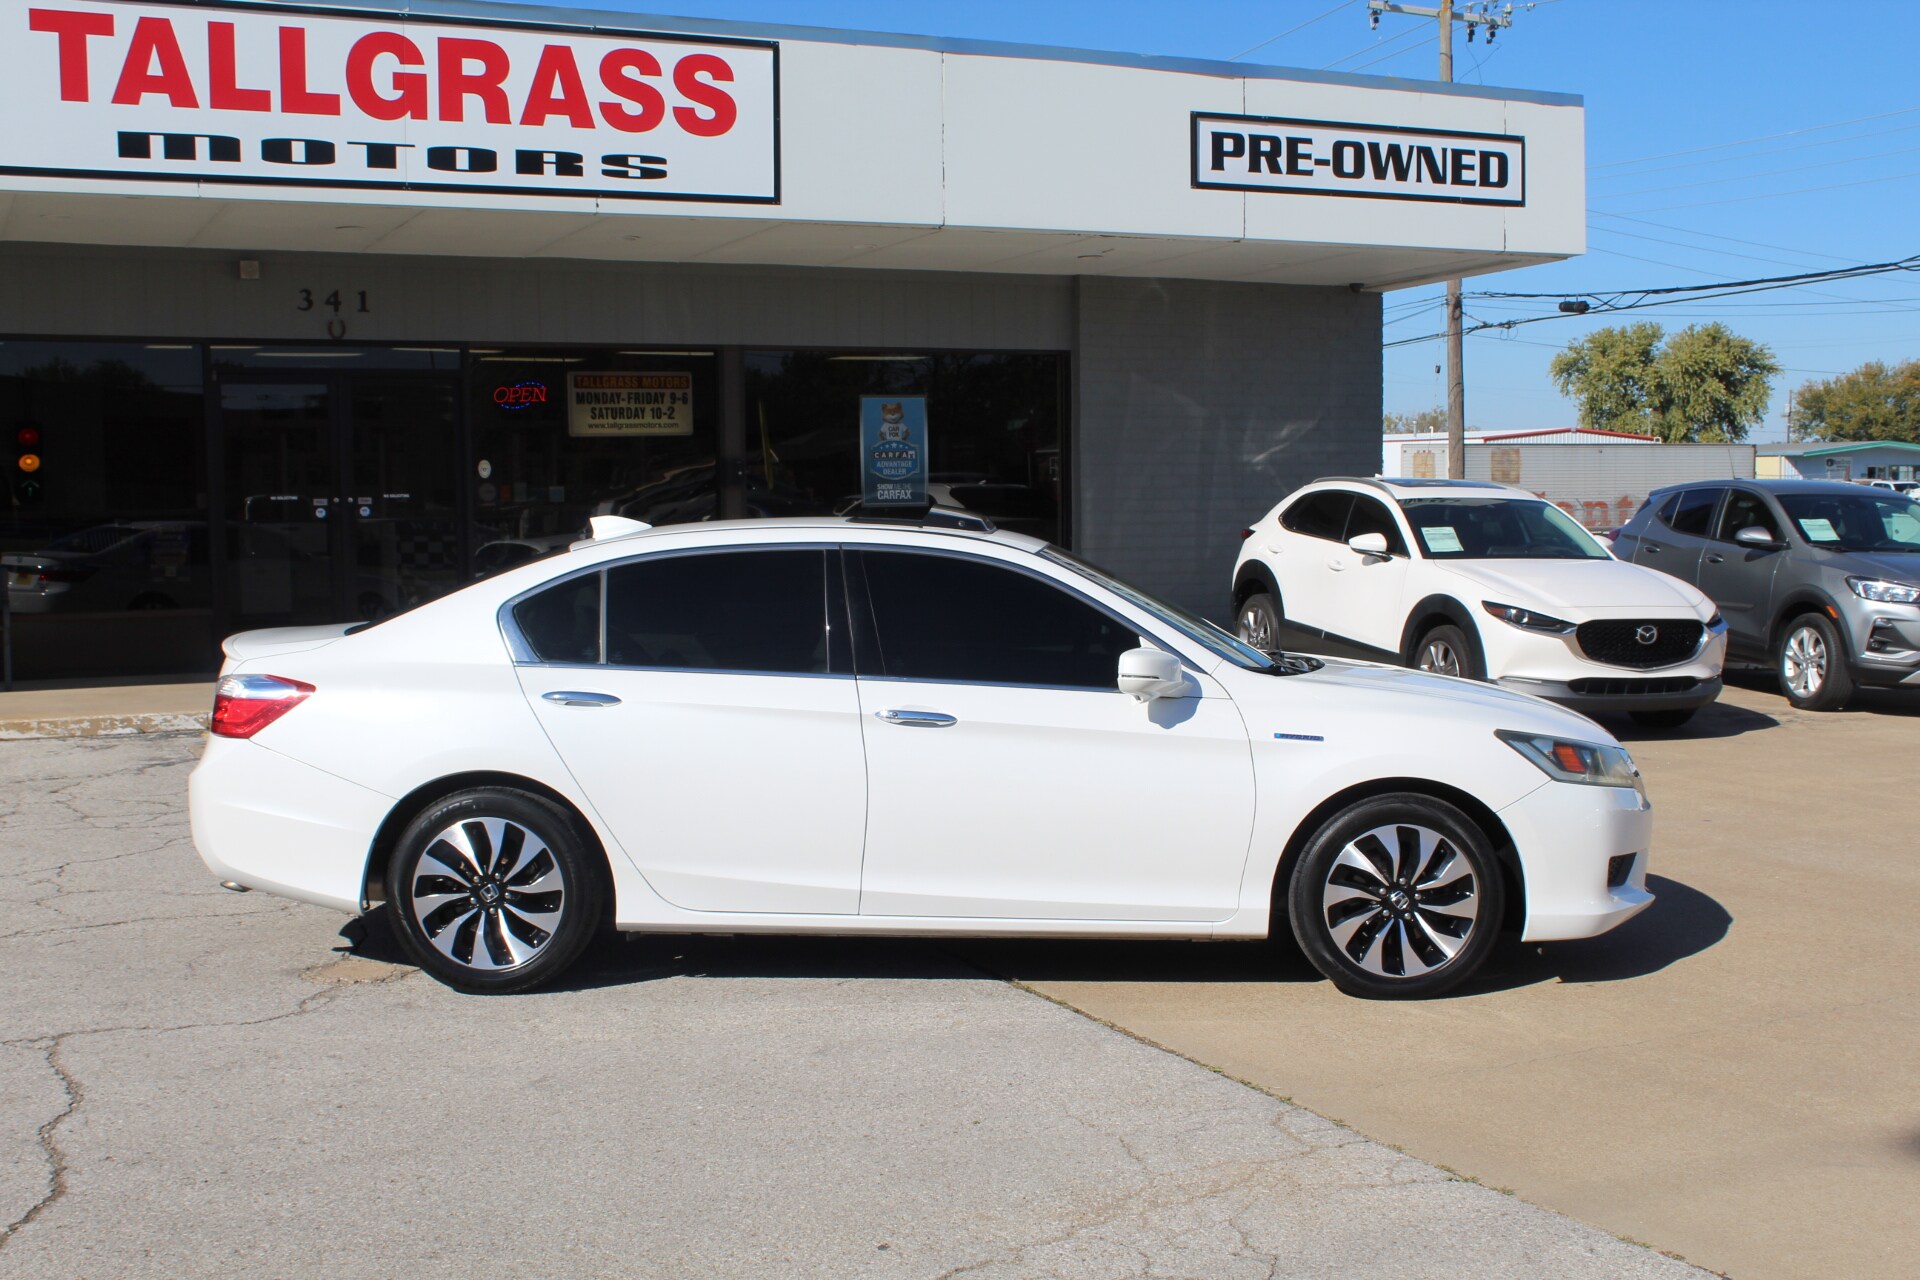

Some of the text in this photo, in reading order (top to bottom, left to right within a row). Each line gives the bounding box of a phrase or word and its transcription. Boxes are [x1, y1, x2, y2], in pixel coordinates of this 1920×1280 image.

[28, 8, 738, 137] TALLGRASS
[117, 130, 668, 180] MOTORS
[1210, 131, 1509, 189] PRE-OWNED
[297, 288, 370, 313] 341
[576, 376, 688, 388] TALLGRASS MOTORS
[493, 385, 548, 404] OPEN
[576, 391, 688, 405] MONDAY-FRIDAY 9-6
[590, 406, 675, 420] SATURDAY 10-2
[877, 490, 912, 500] CARFAX
